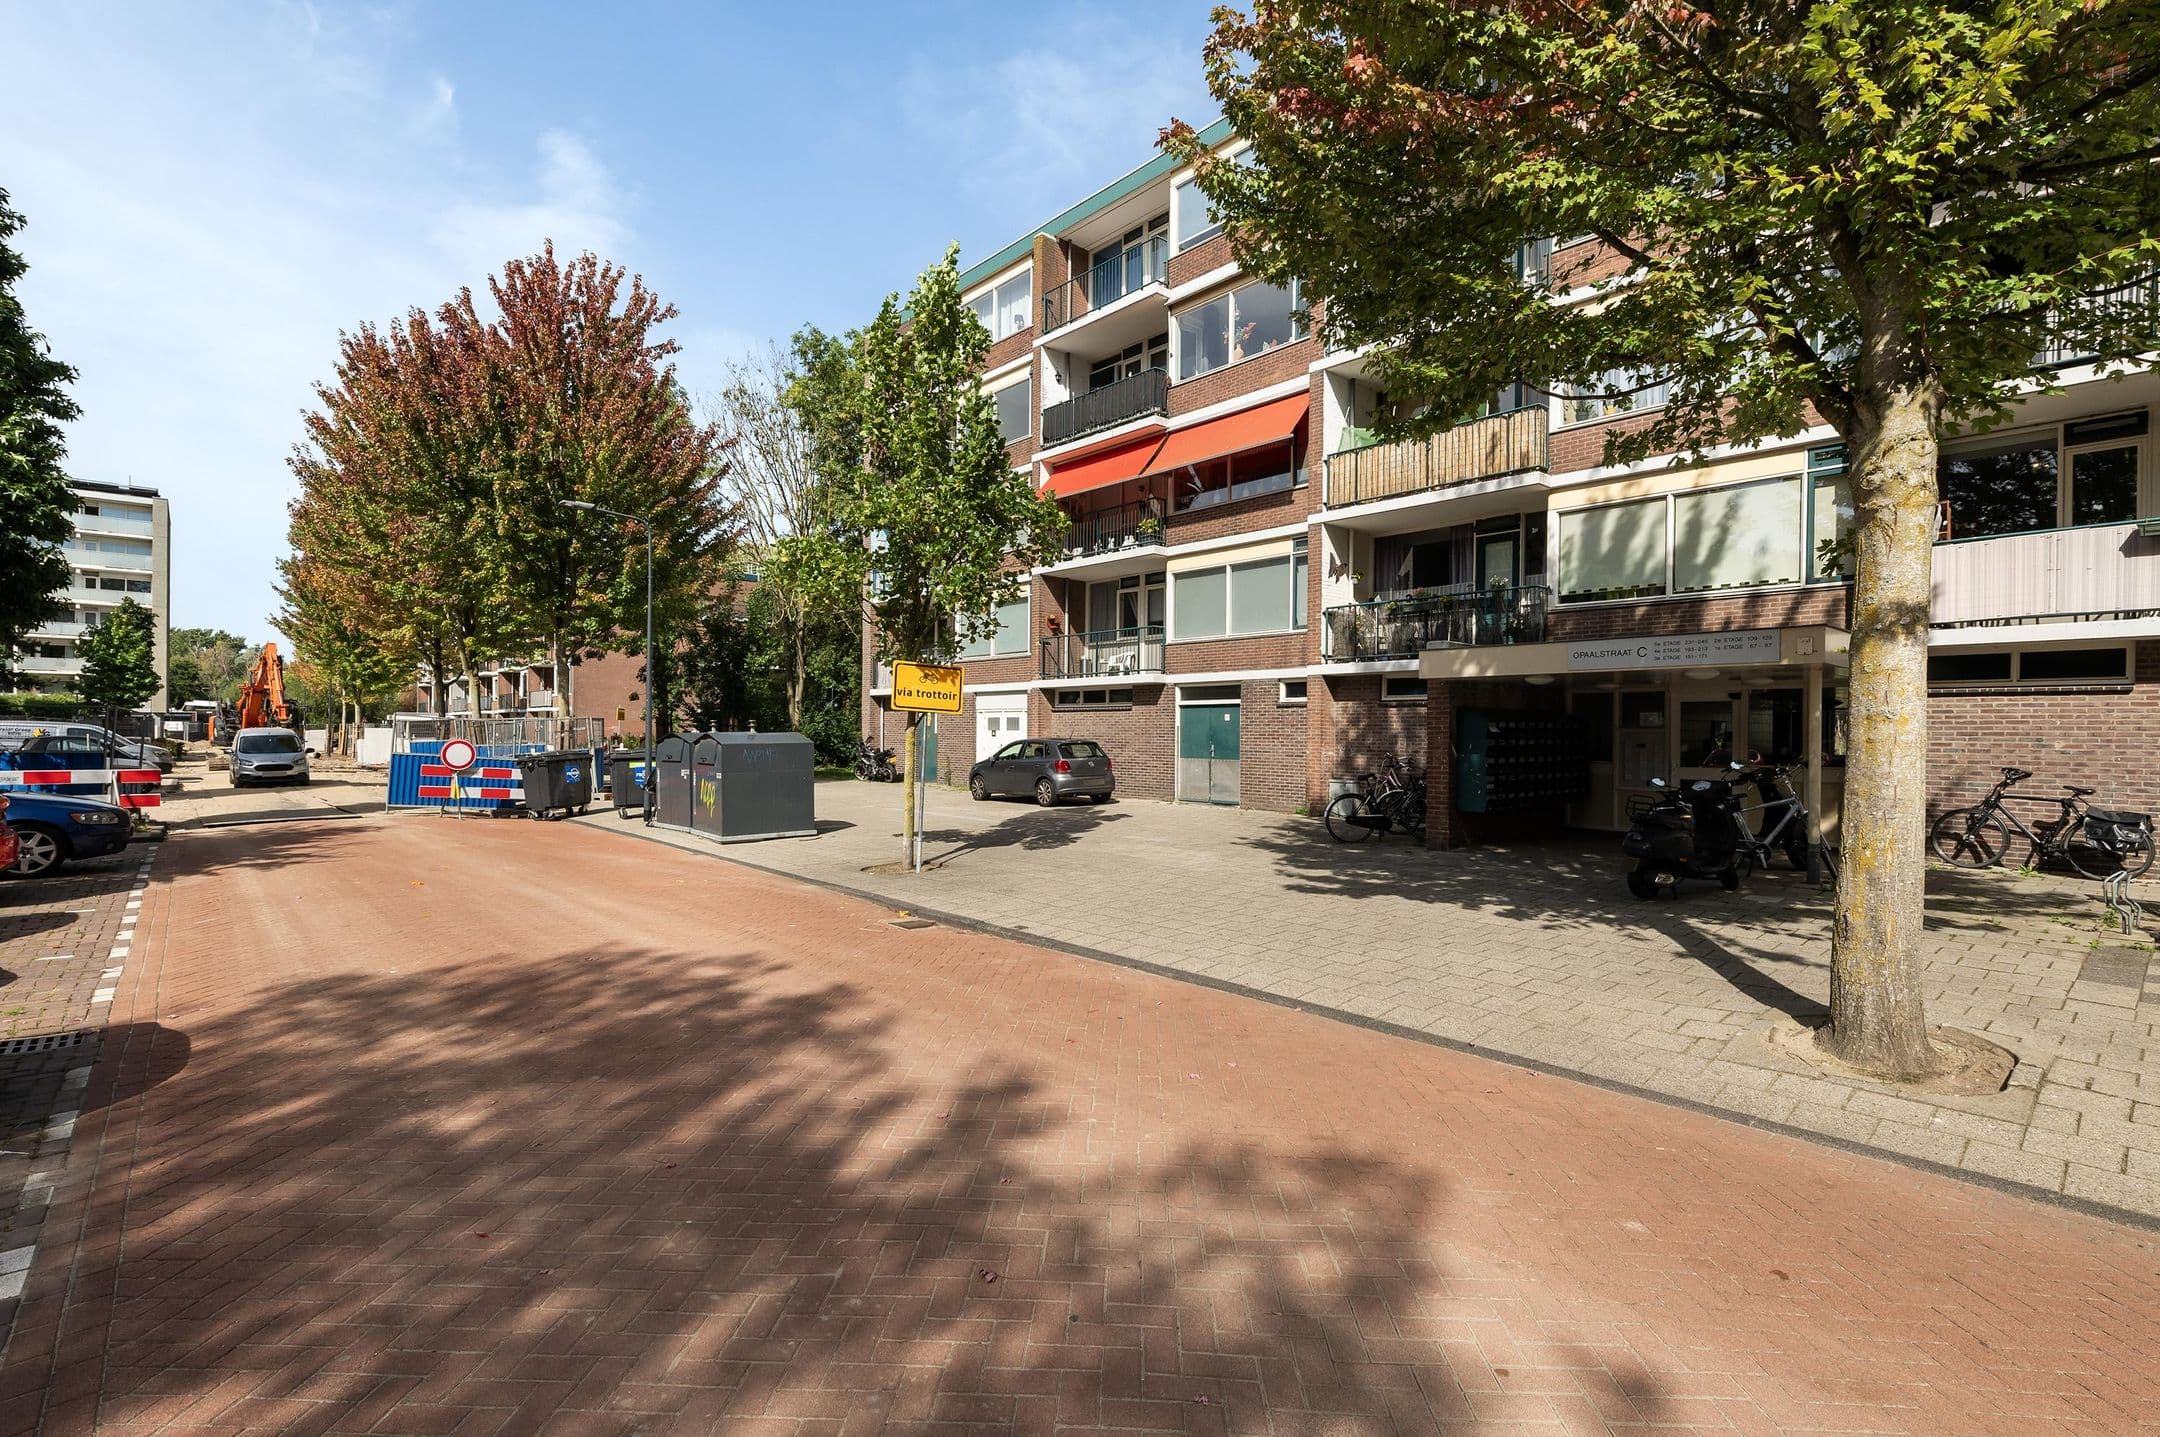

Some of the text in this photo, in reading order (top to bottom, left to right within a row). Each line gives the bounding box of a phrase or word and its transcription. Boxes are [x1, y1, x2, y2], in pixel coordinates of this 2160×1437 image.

[1573, 646, 1648, 659] OPAALSTRAAT C
[897, 687, 957, 700] via trottoir
